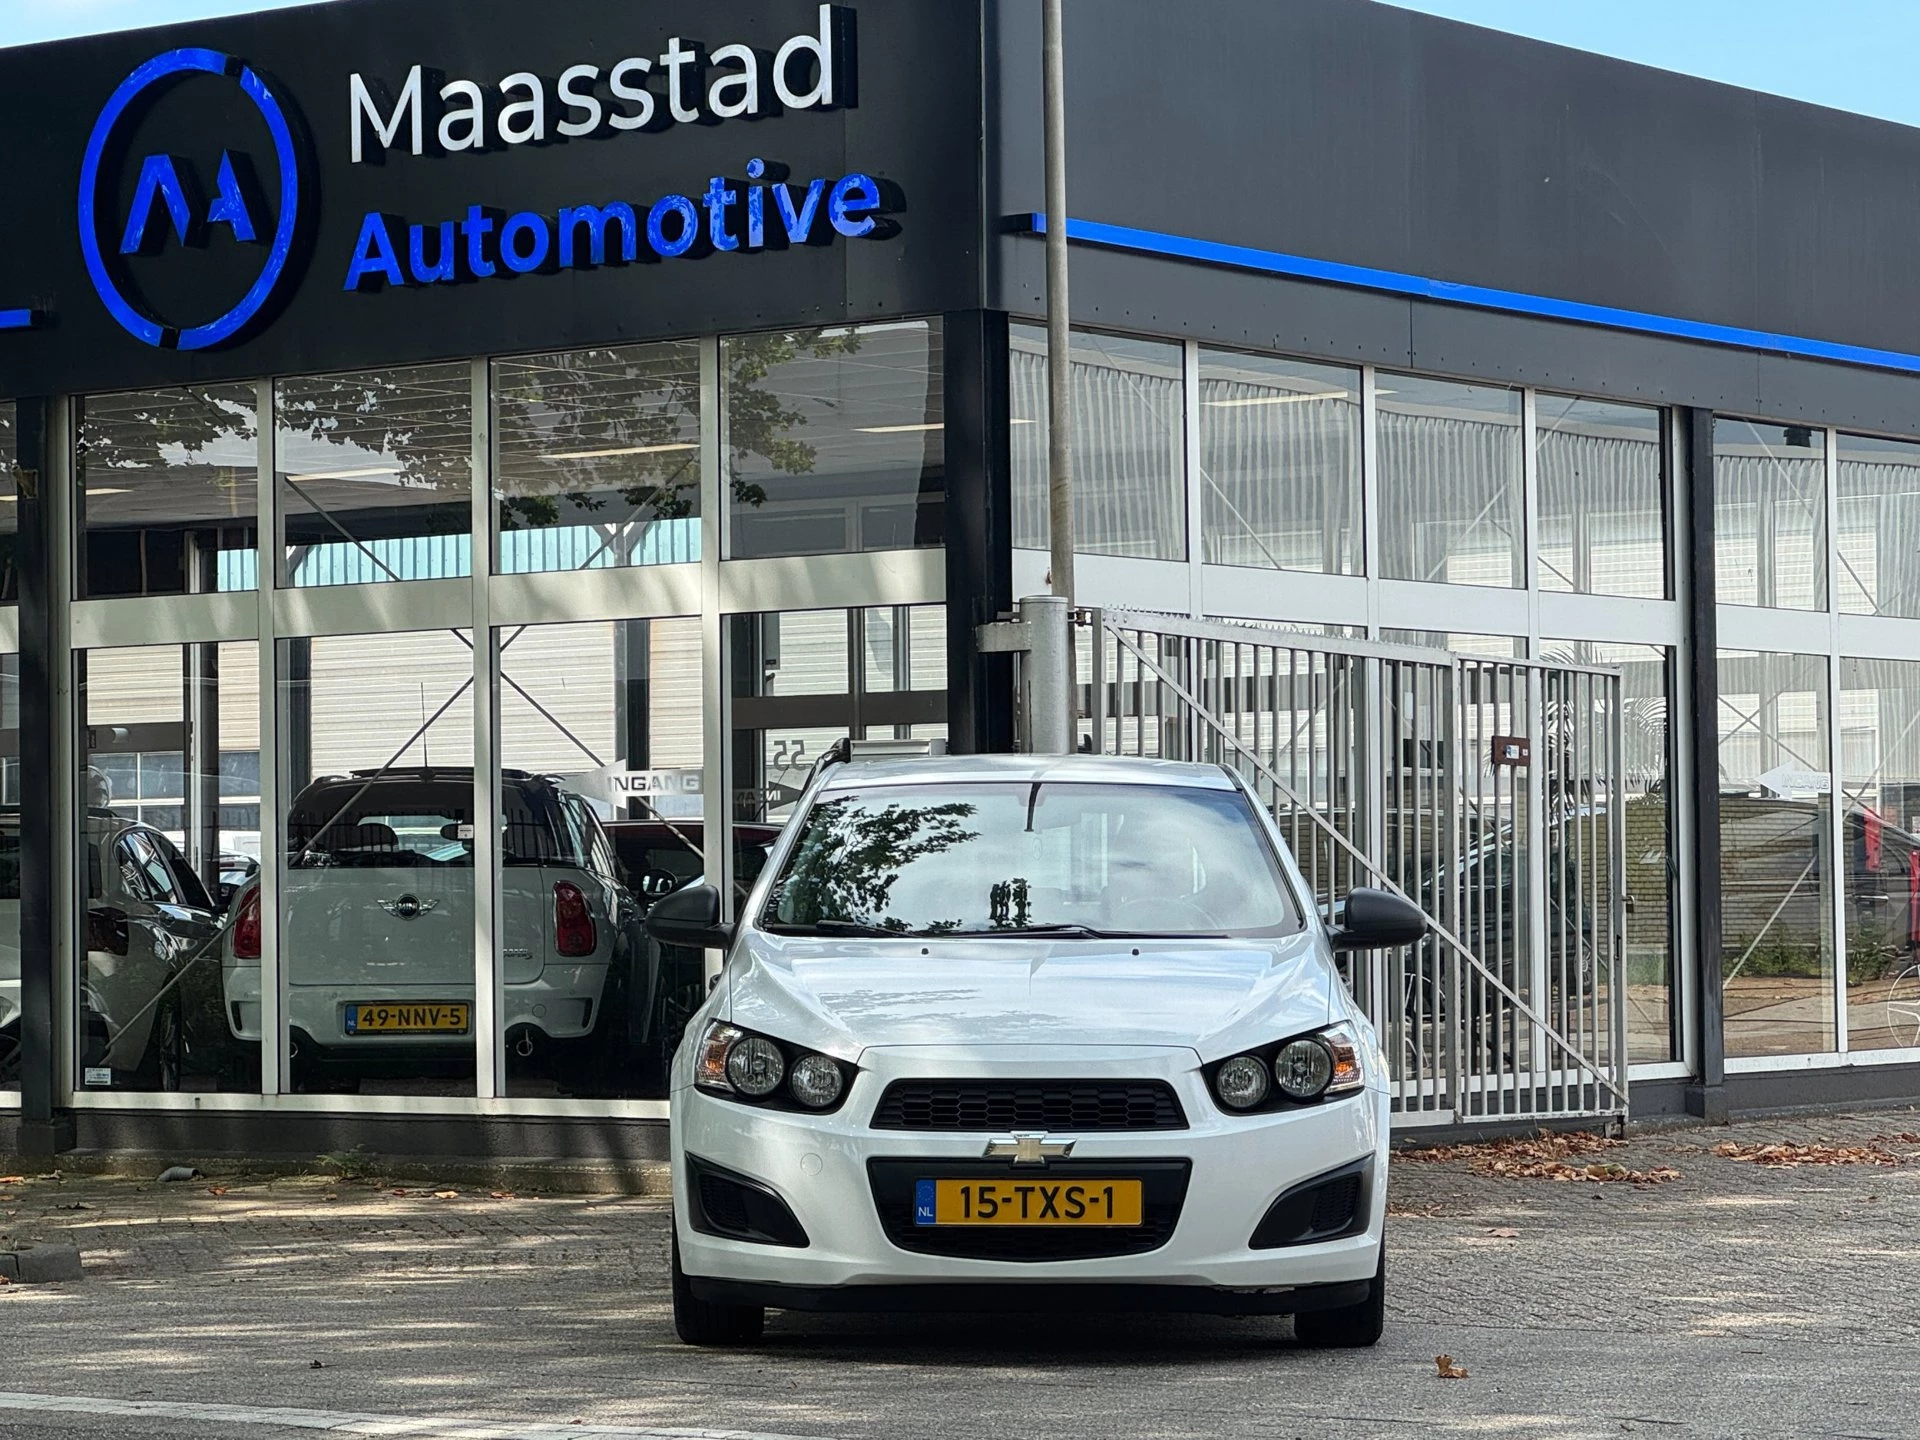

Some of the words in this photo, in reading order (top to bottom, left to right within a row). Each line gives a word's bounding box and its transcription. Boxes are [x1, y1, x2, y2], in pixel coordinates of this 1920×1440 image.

[350, 4, 832, 162] Maasstad
[343, 158, 881, 291] Automotive
[607, 775, 700, 791] INGANG
[362, 1008, 461, 1027] 49-NNV-5
[918, 1207, 933, 1217] NL
[960, 1186, 1113, 1219] 15-TXS-1
